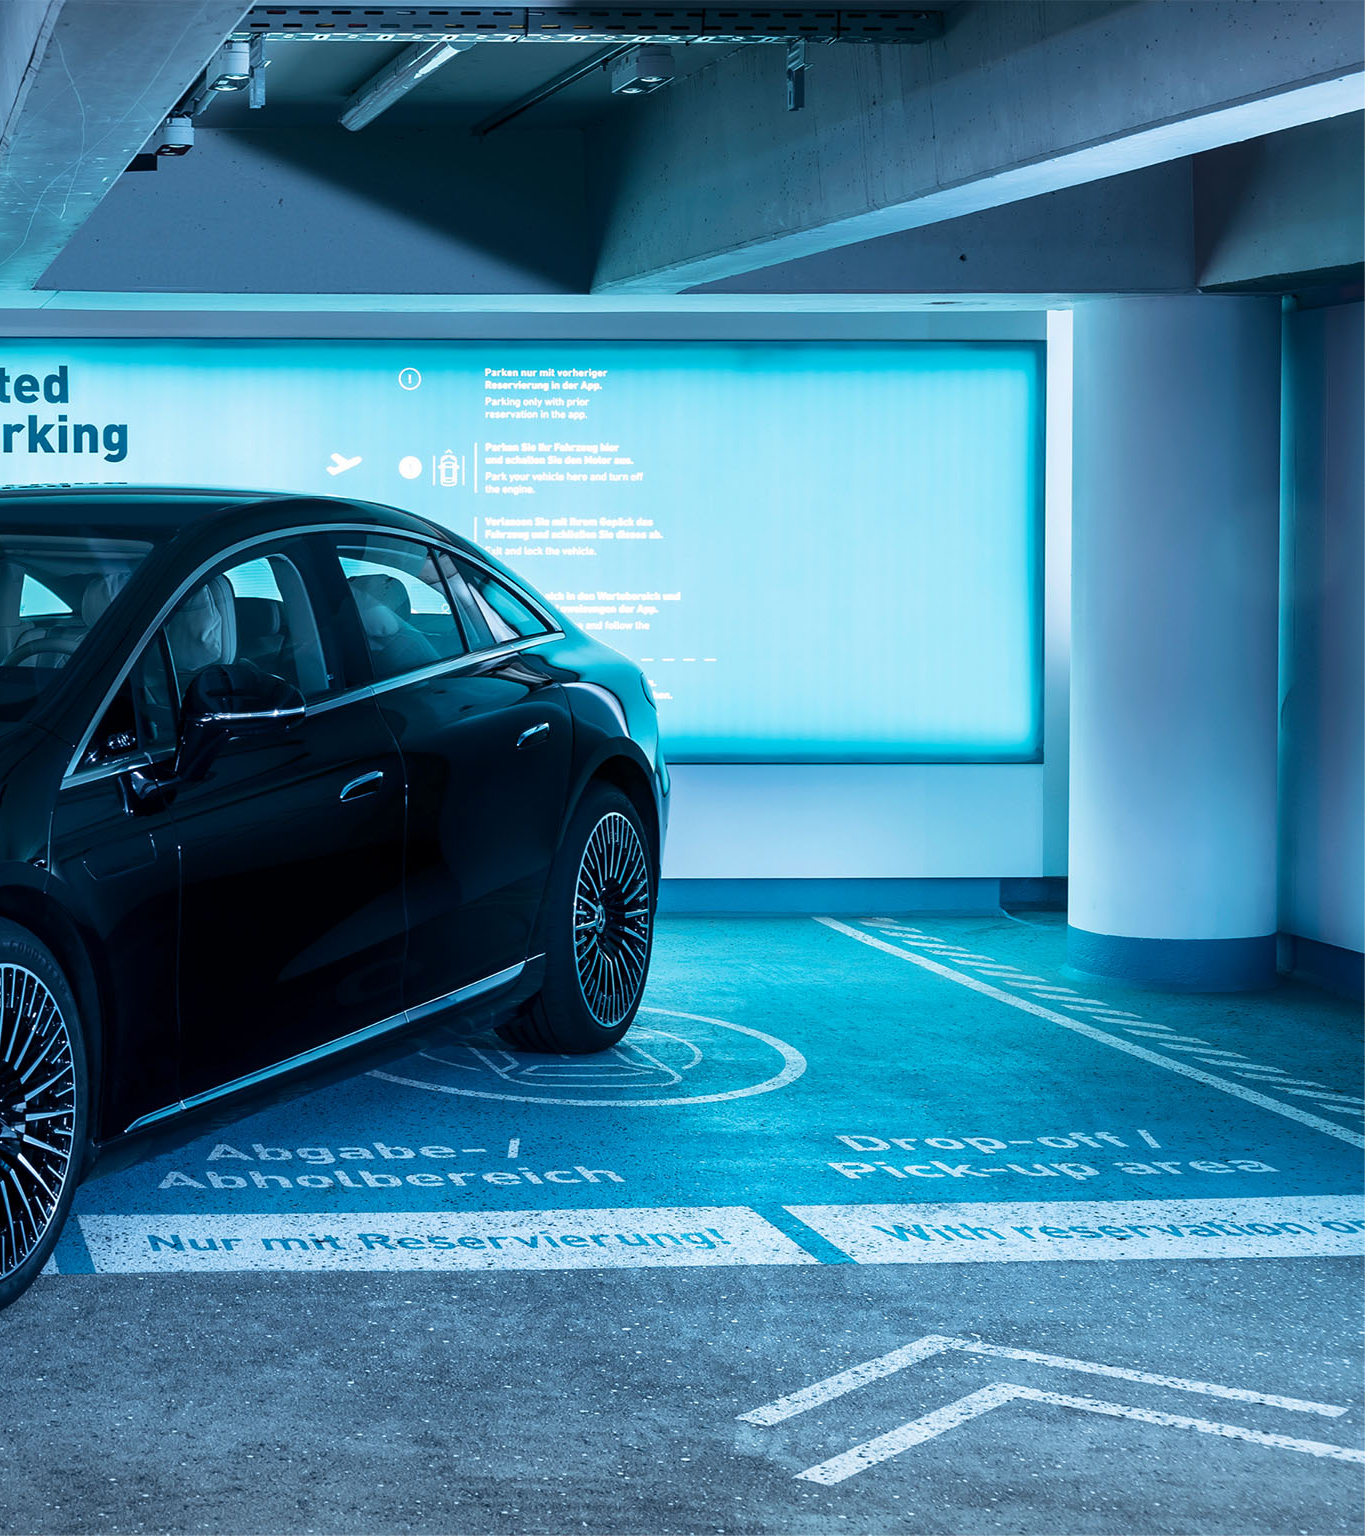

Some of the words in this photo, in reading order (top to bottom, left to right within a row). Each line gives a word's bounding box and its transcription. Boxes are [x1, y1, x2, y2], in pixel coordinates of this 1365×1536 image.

[485, 368, 518, 377] Parken
[539, 368, 555, 377] mit
[557, 368, 608, 379] vorheriger
[485, 380, 549, 392] Reservierung
[551, 380, 560, 390] in
[562, 381, 579, 390] der
[581, 381, 602, 392] App.
[485, 397, 521, 408] Parking
[523, 397, 542, 408] only
[544, 397, 564, 406] with
[566, 397, 590, 408] prior
[485, 410, 538, 419] reservation
[540, 410, 549, 419] in
[551, 410, 566, 419] the
[568, 412, 587, 420] app.
[485, 472, 507, 481] Park
[509, 474, 530, 483] your
[532, 472, 564, 481] vehicle
[566, 472, 587, 481] here
[590, 472, 607, 481] and
[609, 472, 628, 481] turn
[630, 472, 643, 481] off
[485, 485, 500, 493] the
[502, 485, 535, 496] engine.
[504, 546, 521, 555] and
[524, 546, 543, 555] lock
[545, 546, 560, 555] the
[562, 546, 597, 555] vehicle.
[585, 621, 603, 630] and
[605, 621, 633, 631] follow
[635, 621, 649, 630] the
[835, 1130, 1131, 1154] Drop-off
[206, 1141, 486, 1165] Abgabe-
[827, 1160, 1100, 1181] Pick-up
[1121, 1159, 1280, 1176] area
[157, 1166, 626, 1189] Abholbereich
[872, 1222, 1007, 1242] With
[1010, 1219, 1319, 1240] reservation
[147, 1235, 241, 1250] Nur
[261, 1233, 346, 1251] mit
[356, 1227, 732, 1251] Reservierung!
